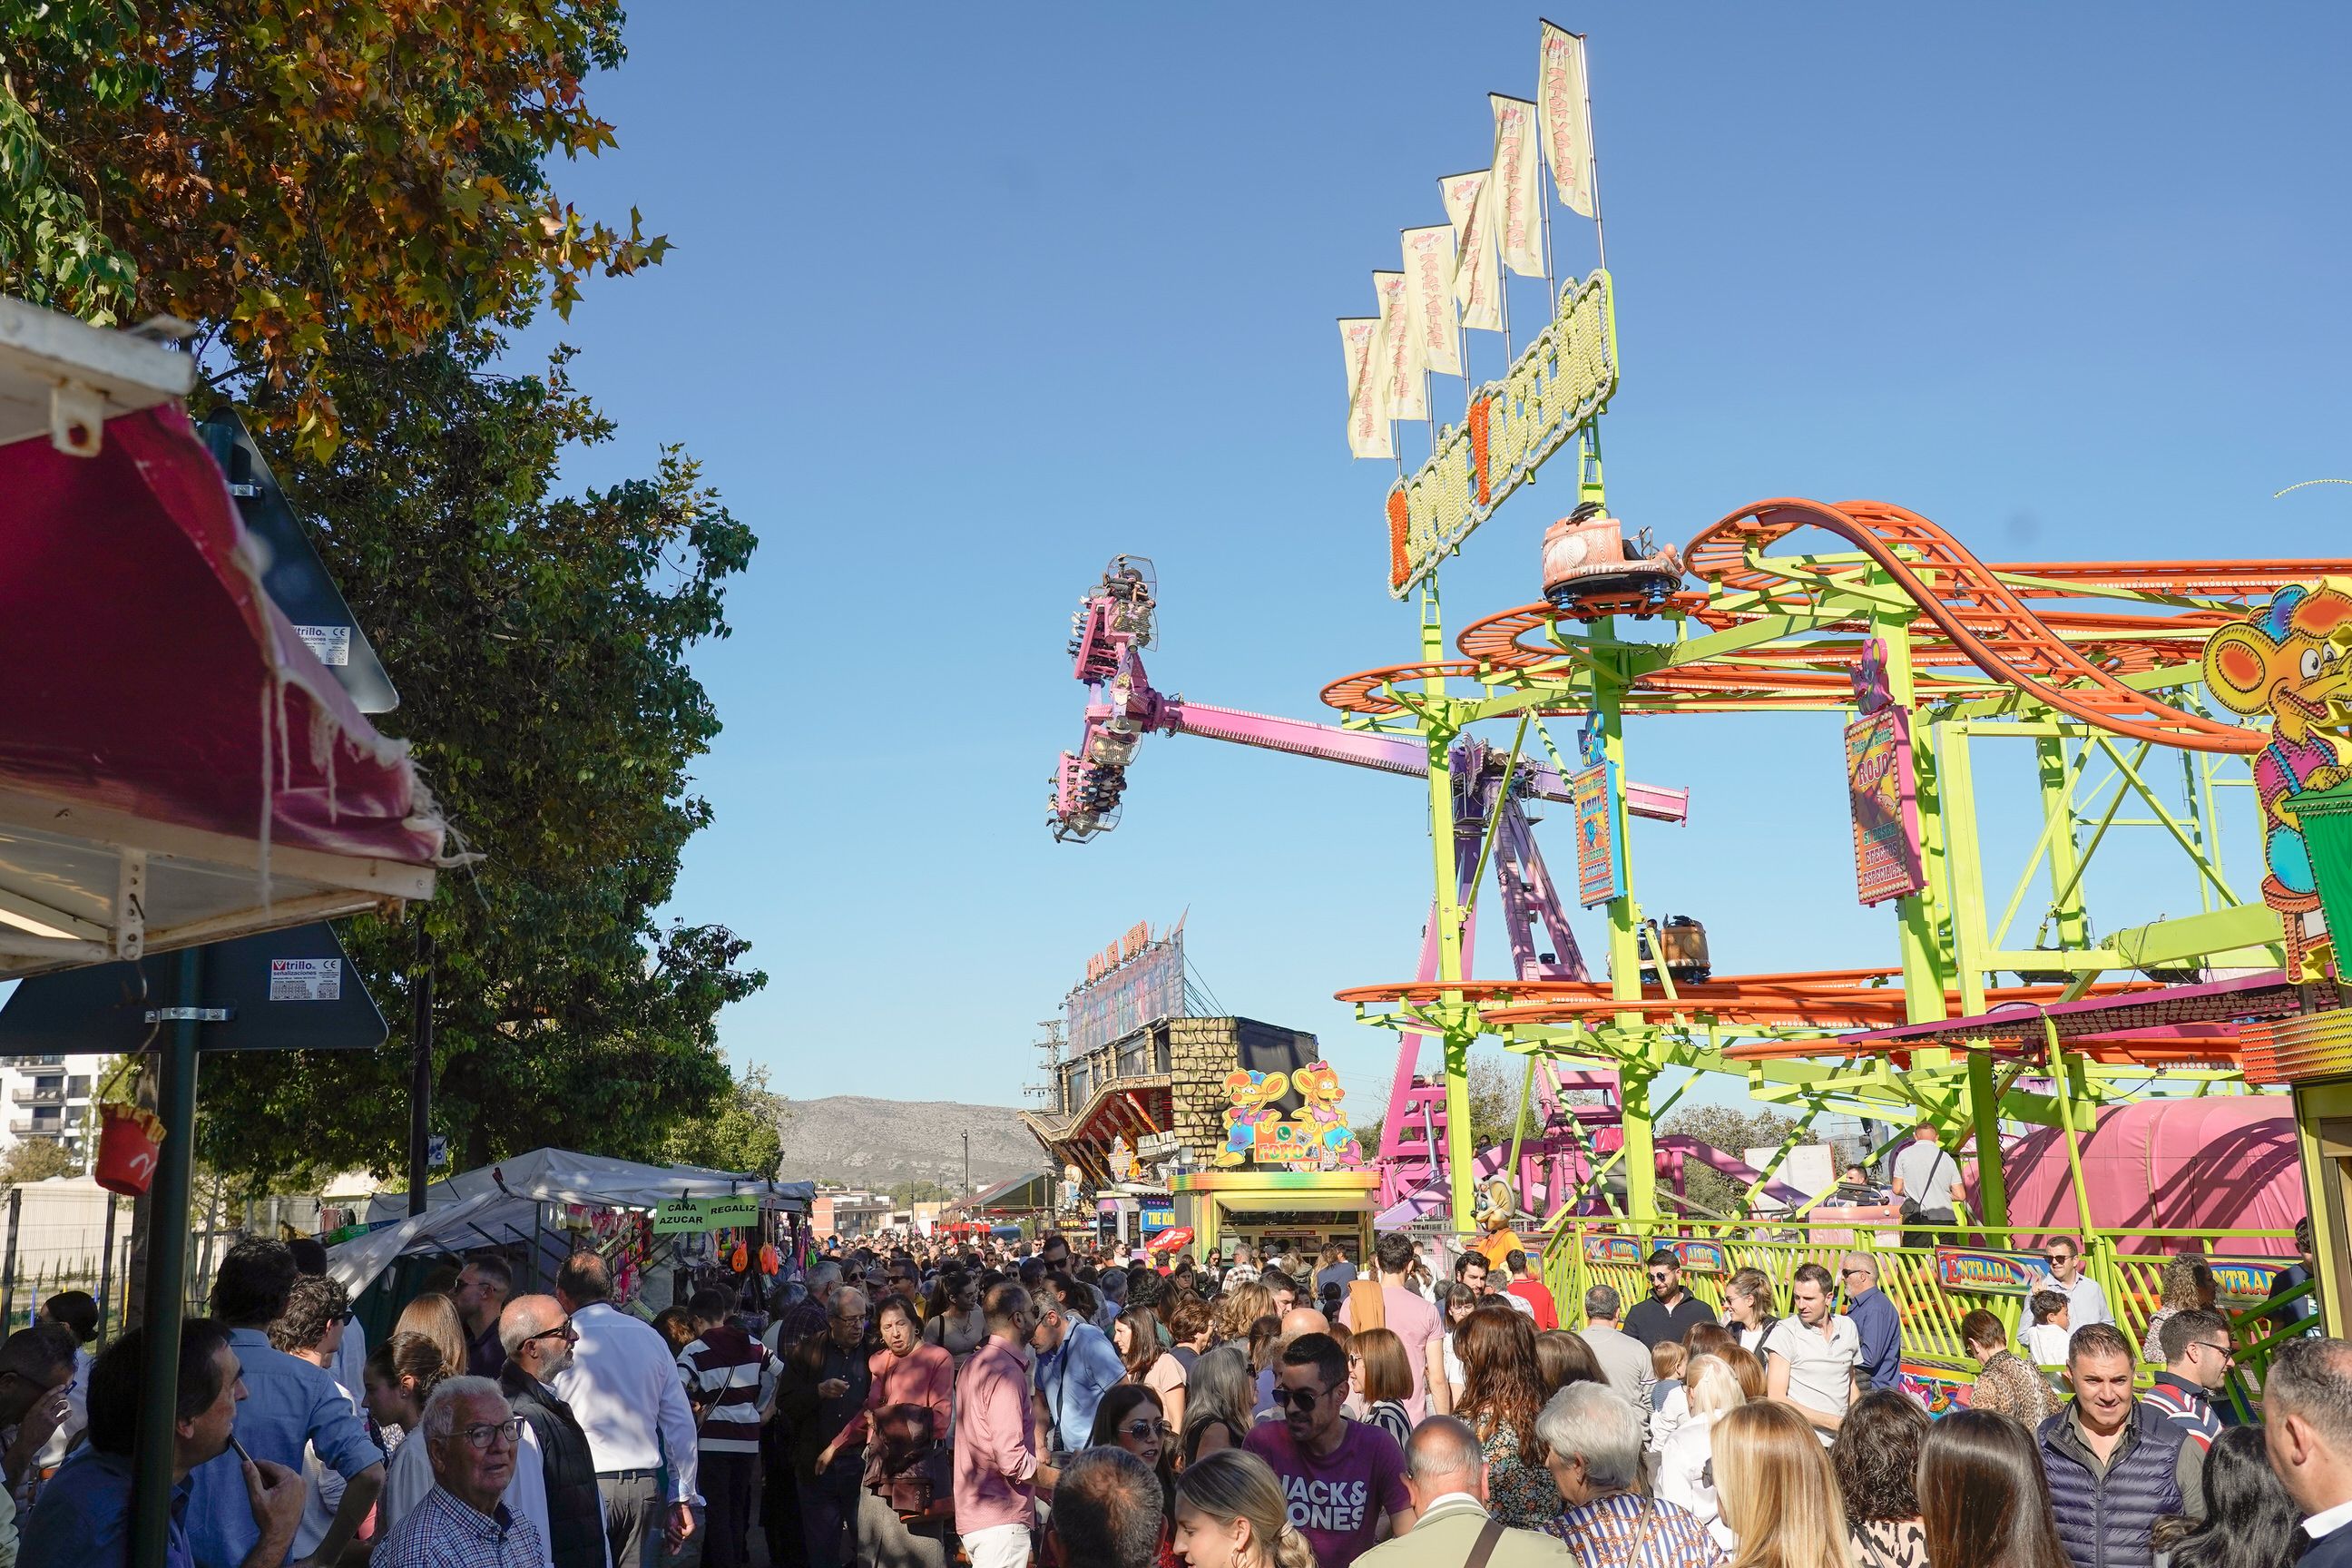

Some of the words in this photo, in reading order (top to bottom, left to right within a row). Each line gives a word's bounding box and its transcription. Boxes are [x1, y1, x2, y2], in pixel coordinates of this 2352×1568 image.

[295, 627, 322, 636] trillo
[1857, 751, 1890, 787] ROJO
[1581, 795, 1602, 819] AZUL
[1863, 829, 1872, 846] SI
[1865, 840, 1898, 867] EFECTOS
[323, 960, 337, 969] CE
[1259, 1143, 1304, 1160] FOTO
[710, 1205, 756, 1215] REGALIZ
[1147, 1211, 1161, 1225] THE
[659, 1216, 703, 1225] AZUCAR
[1602, 1239, 1633, 1260] SALIDA
[1679, 1242, 1714, 1266] SALIDA
[1945, 1254, 2015, 1284] ENTRADA
[1287, 1502, 1365, 1531] ONES
